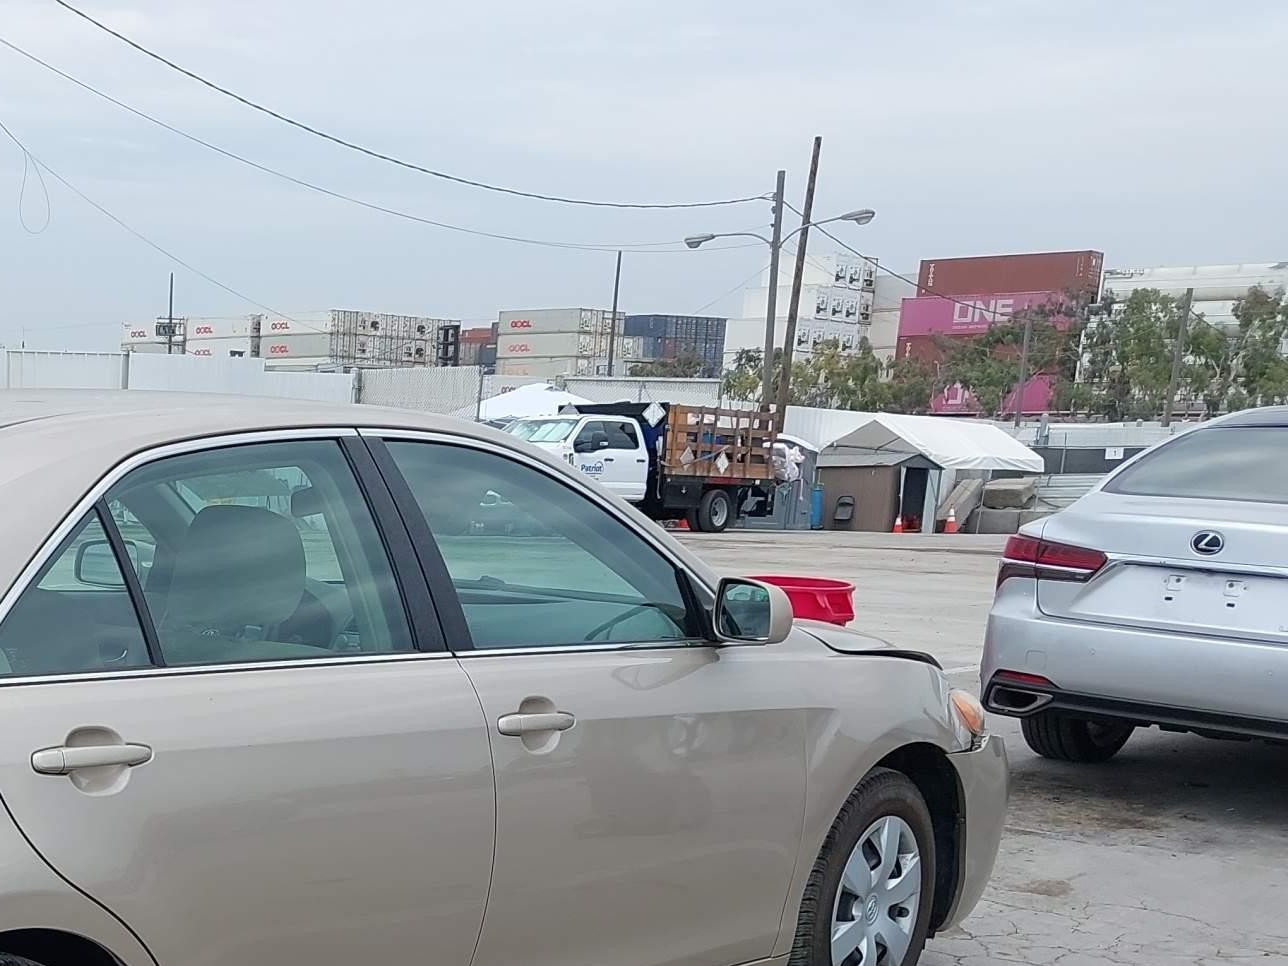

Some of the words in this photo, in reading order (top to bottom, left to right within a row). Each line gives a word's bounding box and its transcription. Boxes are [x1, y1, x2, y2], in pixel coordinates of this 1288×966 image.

[952, 299, 1015, 323] ONE
[271, 321, 290, 330] OOCL
[510, 320, 532, 328] OOCL
[131, 330, 147, 338] OOCL
[196, 326, 213, 334] OOCL
[270, 345, 289, 353] OOCL
[581, 463, 603, 472] Patriot
